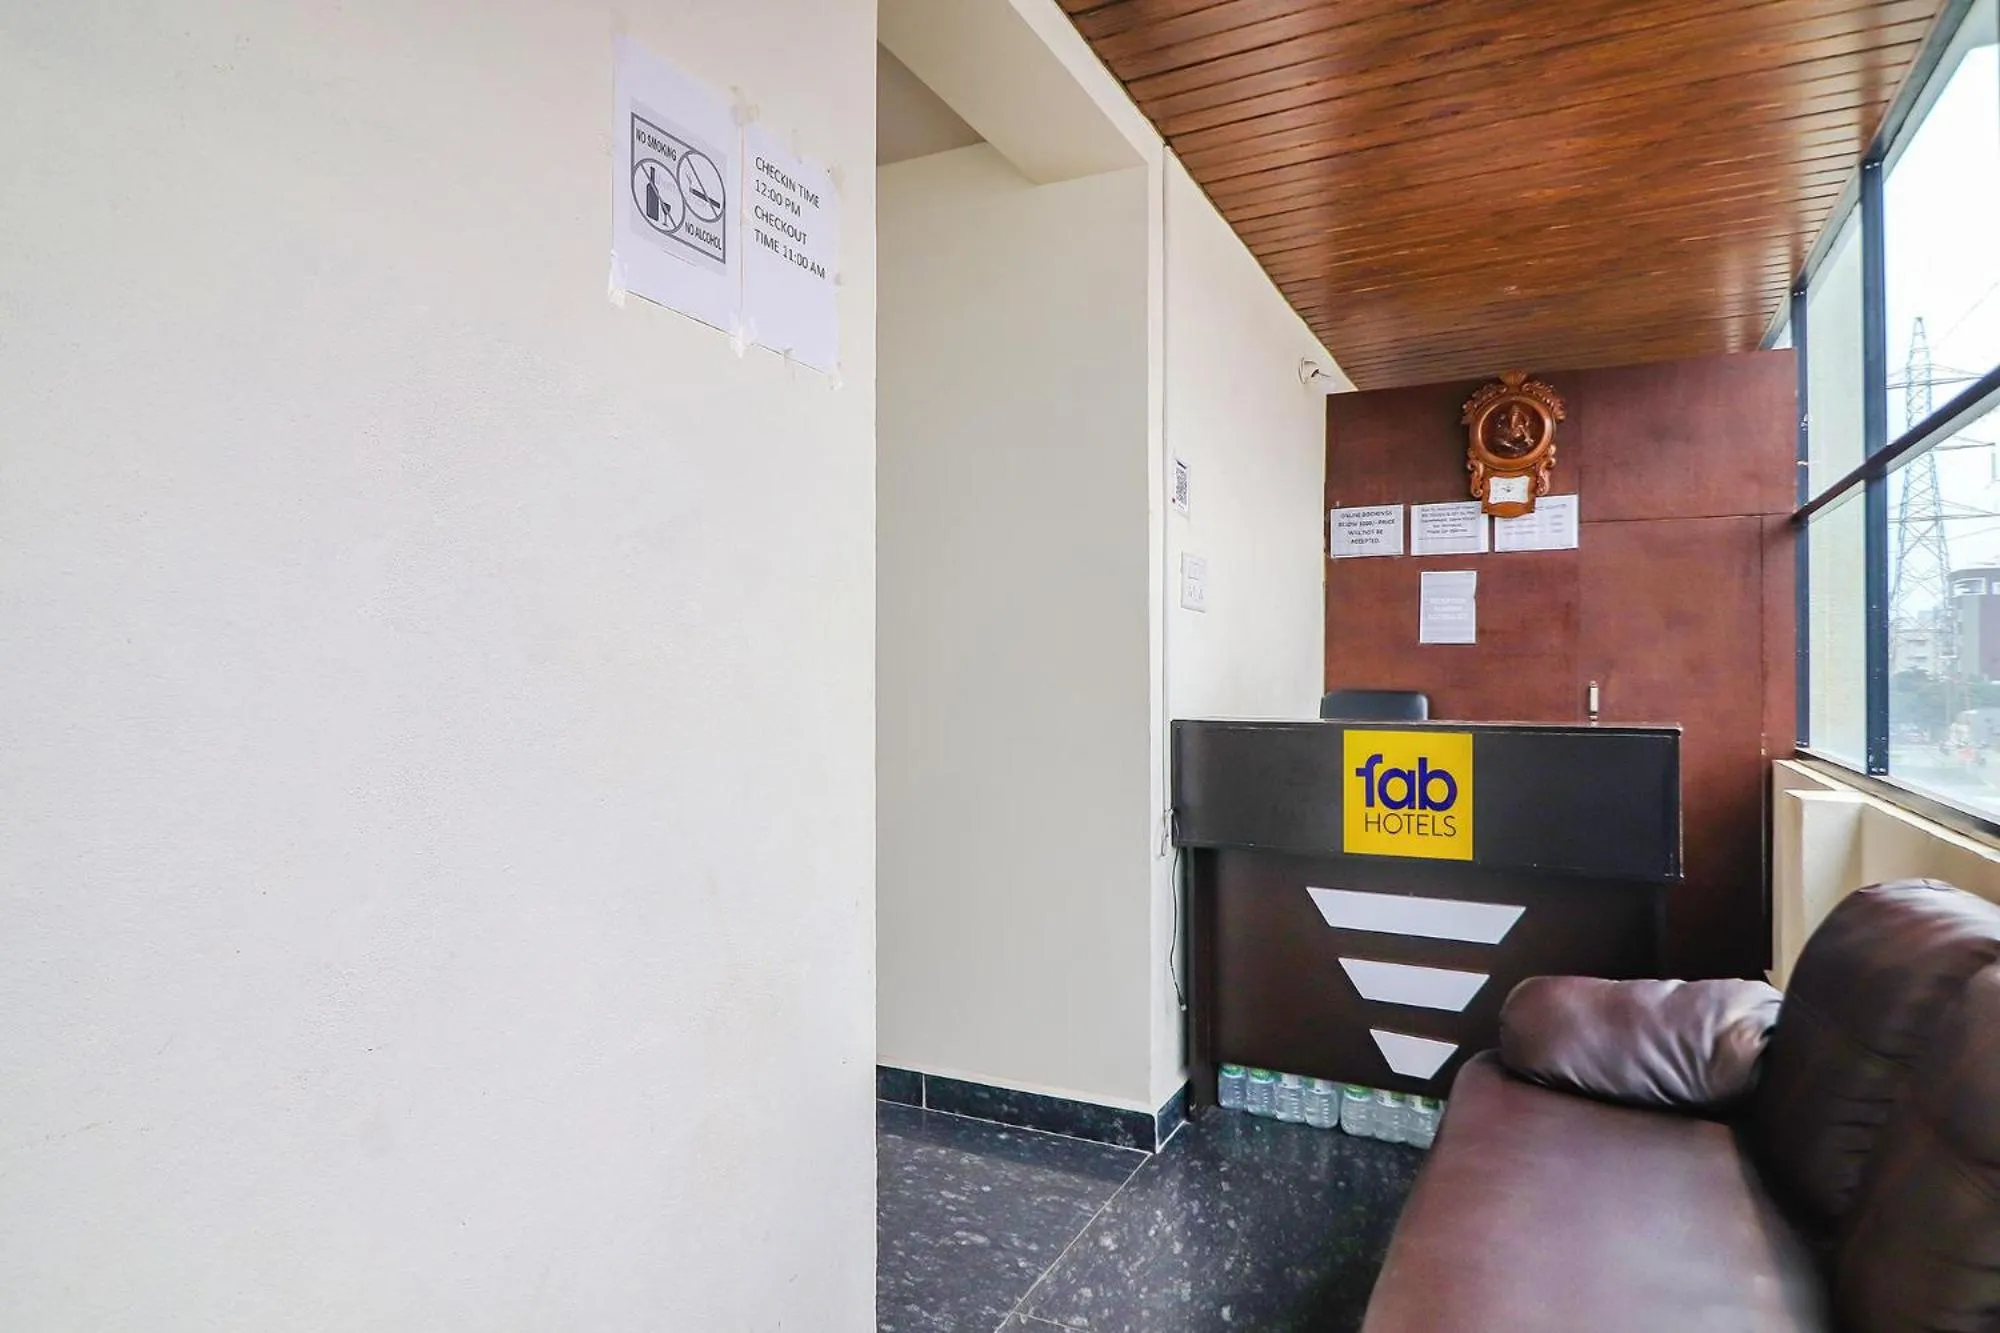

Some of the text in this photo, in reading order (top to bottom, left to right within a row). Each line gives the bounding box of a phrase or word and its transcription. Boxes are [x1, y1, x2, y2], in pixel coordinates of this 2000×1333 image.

[636, 127, 677, 162] NO SMOKING
[755, 156, 821, 209] CHECKIN TIME
[755, 179, 801, 217] 12:00 PM
[685, 221, 722, 251] NO ALCOHOL
[754, 205, 807, 245] CHECKOUT
[754, 228, 826, 279] TIME 11:00 AM
[1355, 753, 1458, 812] fab
[1364, 812, 1457, 838] HOTELS
